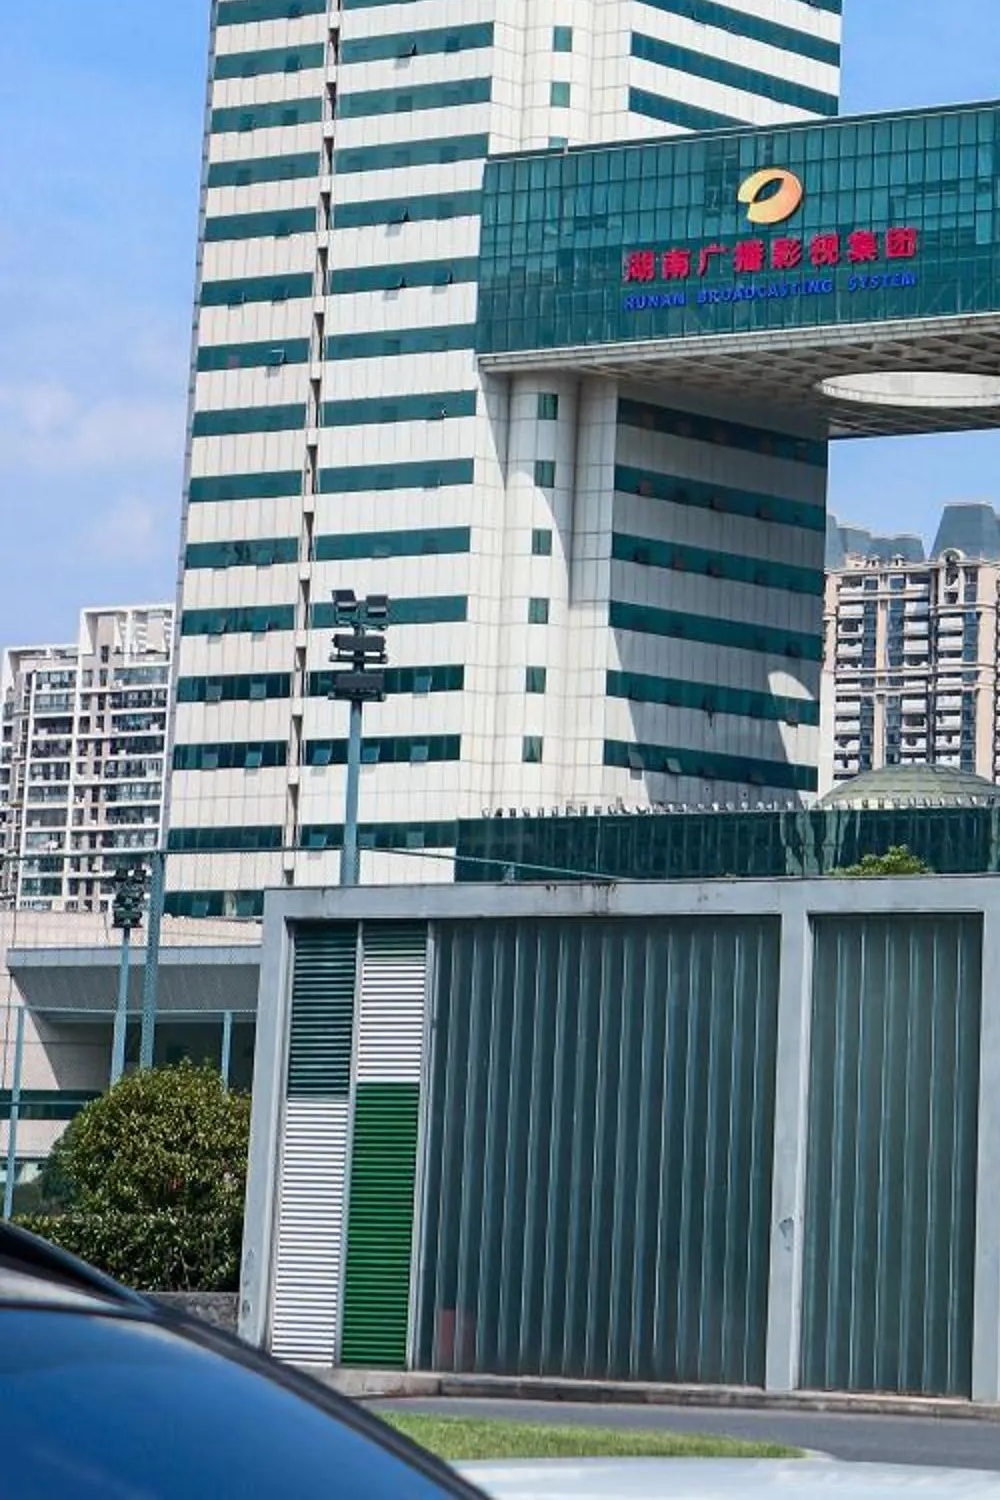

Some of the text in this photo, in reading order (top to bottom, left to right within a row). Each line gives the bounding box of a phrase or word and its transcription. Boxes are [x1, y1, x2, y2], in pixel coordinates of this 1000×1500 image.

[624, 227, 917, 282] 湖南广播影视集团
[625, 272, 916, 310] HUNAN BROADCASTING SYSTEM
